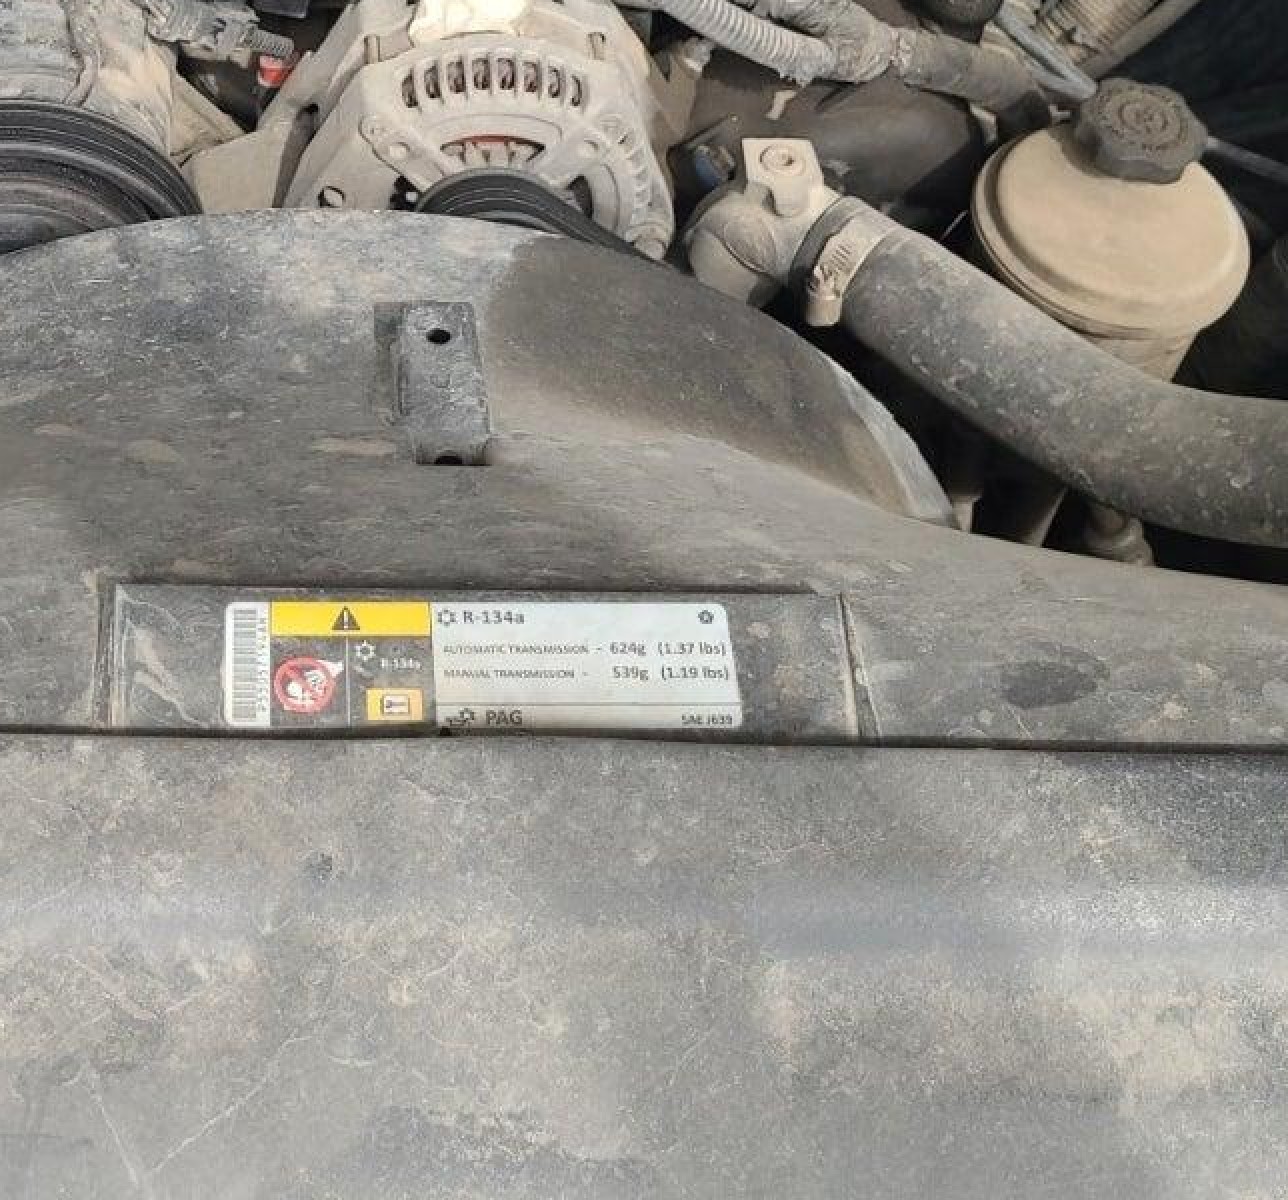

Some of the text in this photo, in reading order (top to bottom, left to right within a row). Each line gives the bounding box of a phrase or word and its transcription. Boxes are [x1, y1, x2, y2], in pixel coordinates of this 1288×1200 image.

[463, 609, 525, 625] R-134a
[443, 644, 503, 655] AUTOMATIC
[508, 644, 589, 655] TRANSMISSION
[610, 641, 647, 657] 624g
[657, 641, 695, 657] (1.37
[699, 641, 727, 657] lbs)
[443, 669, 491, 679] MANUAL
[494, 669, 575, 679] TRANSMISSION
[613, 665, 650, 681] 539g
[661, 665, 699, 681] (1.19
[701, 665, 729, 681] lbs)
[485, 709, 523, 726] PAG
